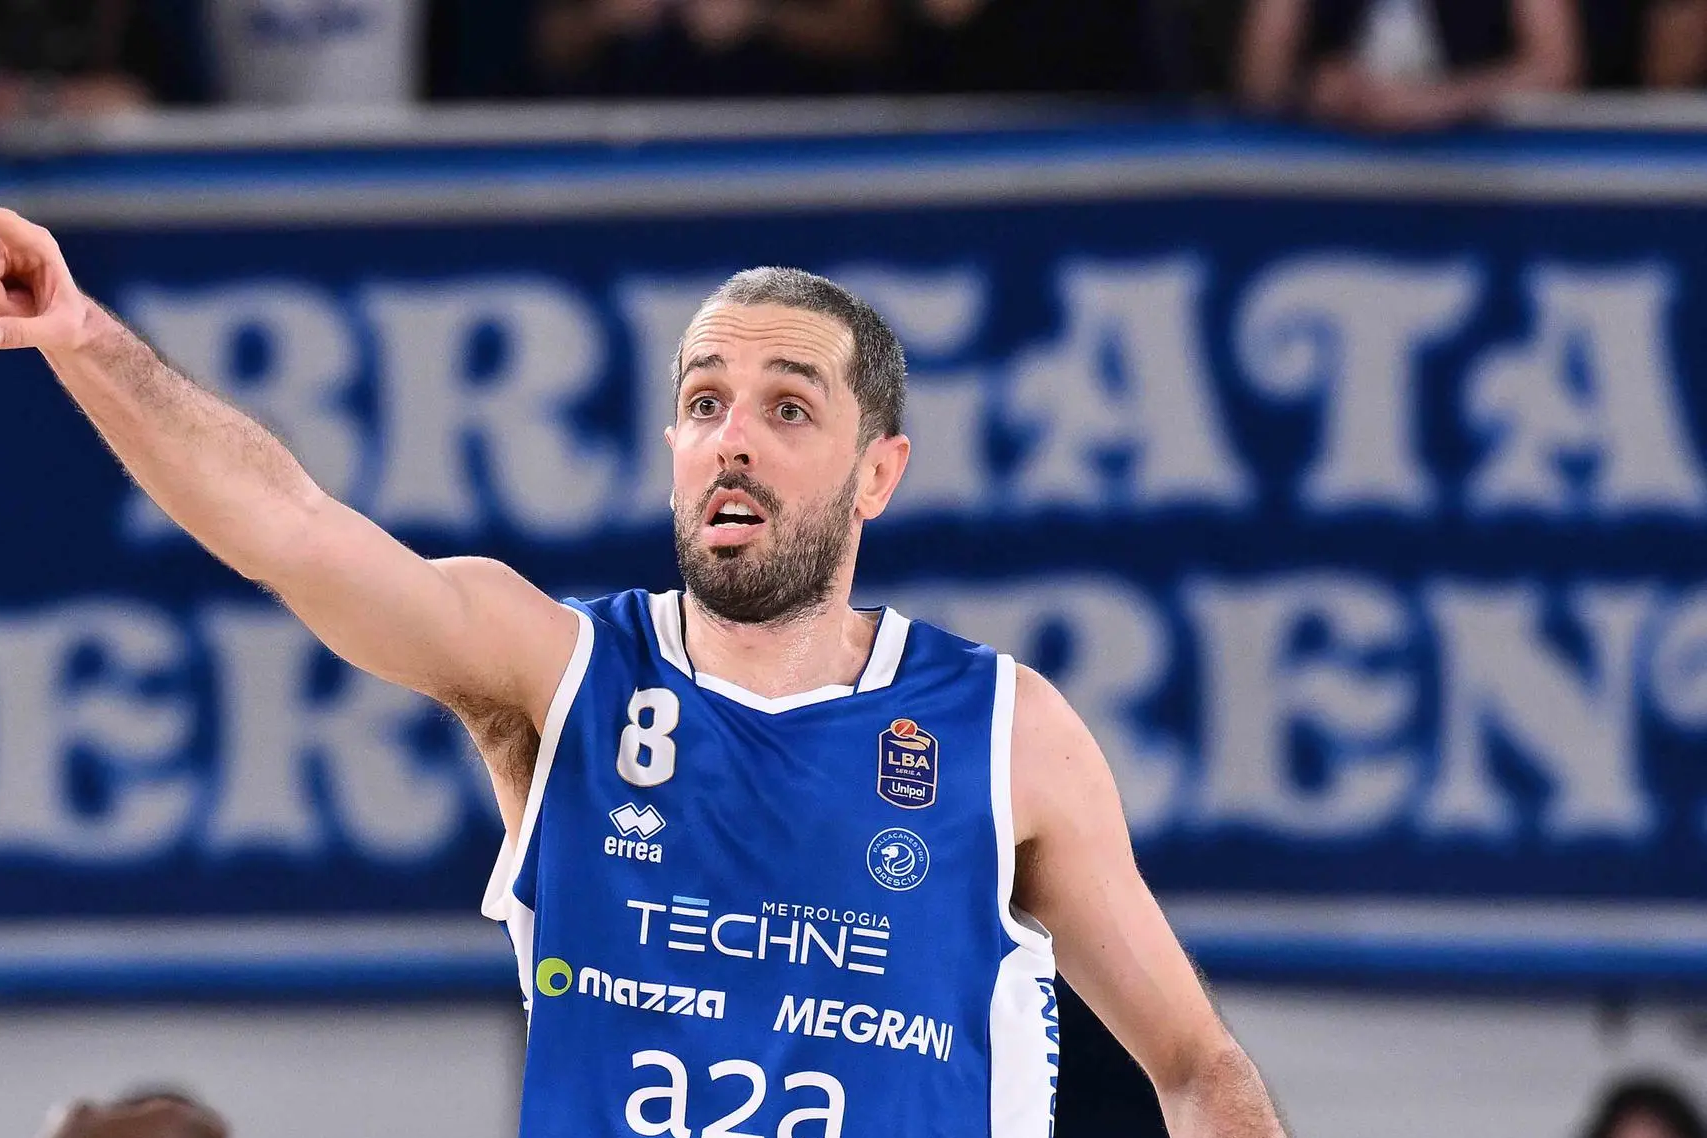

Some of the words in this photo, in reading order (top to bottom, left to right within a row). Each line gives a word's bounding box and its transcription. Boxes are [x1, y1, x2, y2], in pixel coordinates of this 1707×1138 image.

[616, 687, 680, 787] 8
[888, 751, 930, 769] LBA
[895, 768, 916, 776] SERIE
[892, 781, 926, 798] Unipol
[874, 866, 918, 886] BRESCIA
[762, 901, 891, 929] METROLOGIA
[578, 966, 726, 1019] mazza
[773, 995, 954, 1062] MEGRANI
